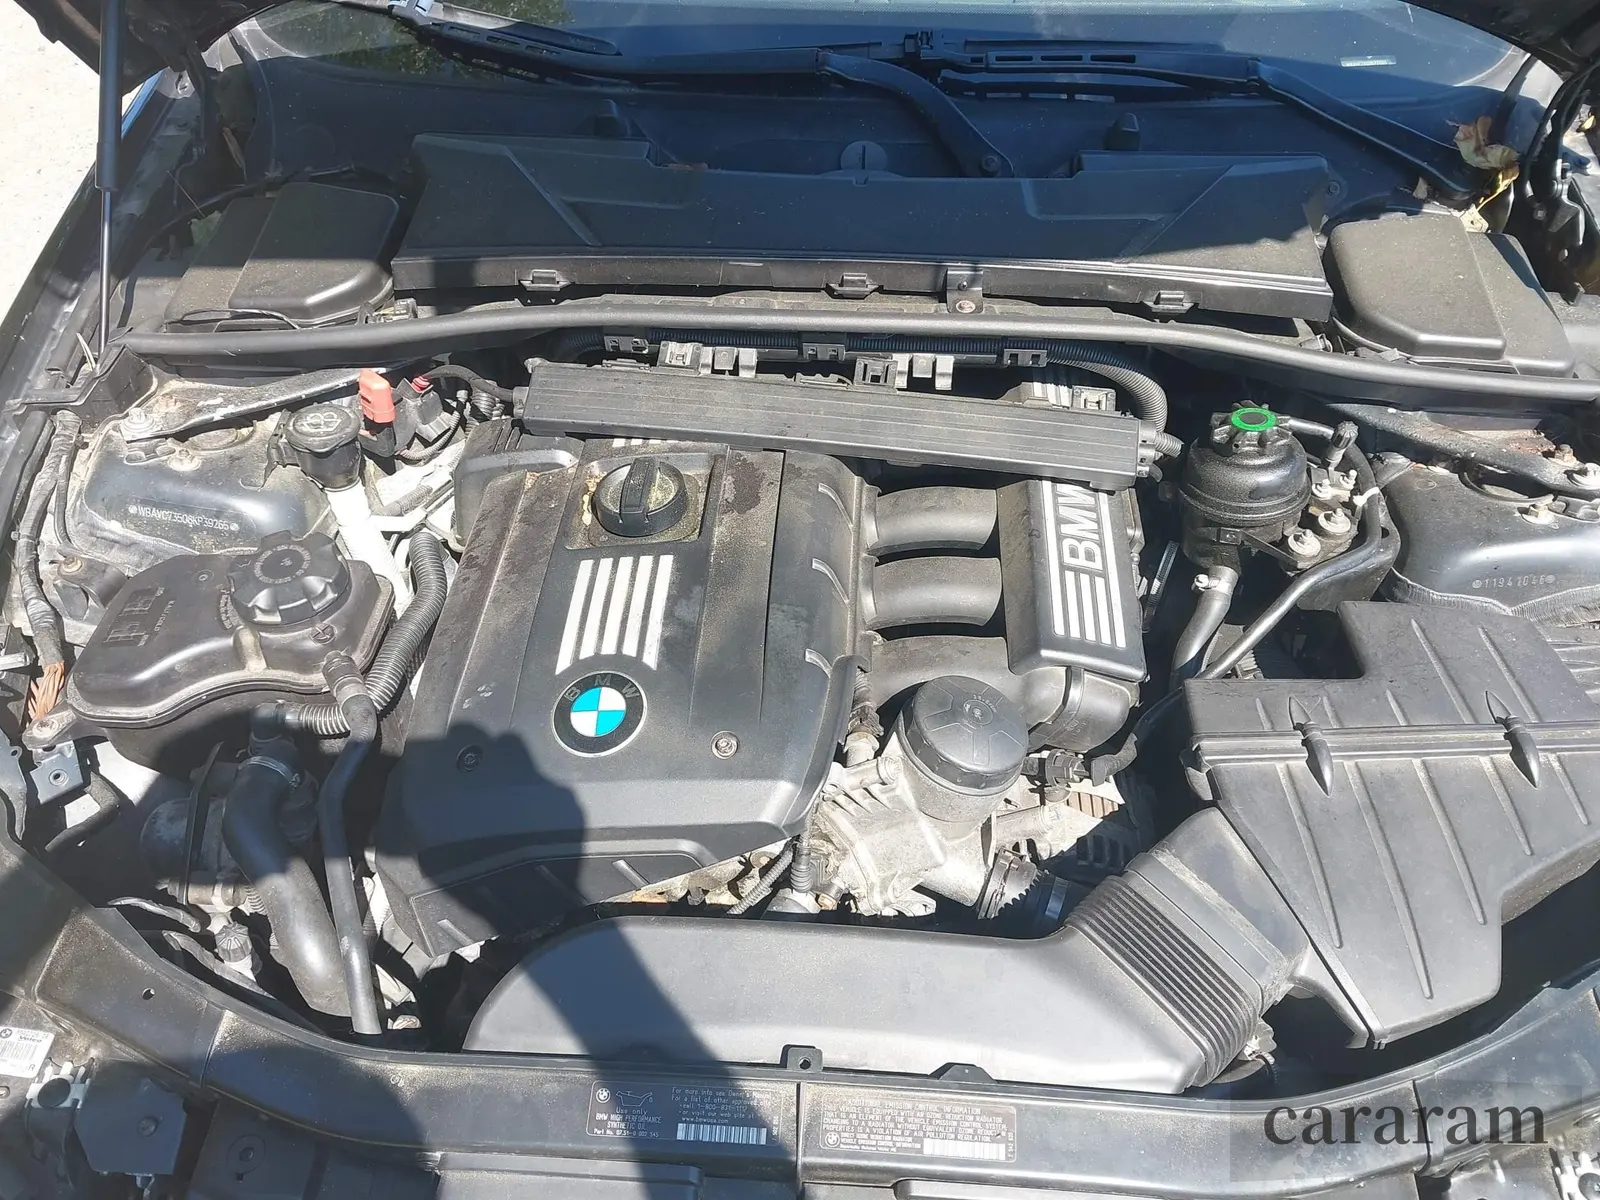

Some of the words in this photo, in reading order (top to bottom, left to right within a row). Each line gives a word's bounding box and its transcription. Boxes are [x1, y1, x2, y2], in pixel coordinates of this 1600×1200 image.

[1056, 483, 1104, 571] BMW
[564, 674, 640, 702] BMW
[885, 1101, 912, 1109] EMISSION
[914, 1103, 940, 1112] CONTROL
[943, 1105, 981, 1114] INFORMATION
[607, 1121, 636, 1129] SYNTHETIC
[610, 1113, 623, 1121] HIGH
[625, 1114, 662, 1123] PERFORMANCE
[823, 1117, 850, 1125] CHANGING
[922, 1125, 956, 1133] EQUIVALENT
[858, 1113, 882, 1121] ELEMENT
[908, 1117, 930, 1125] VEHICLE
[932, 1119, 958, 1127] EMISSION
[945, 1113, 974, 1121] REDUCTION
[976, 1116, 1003, 1124] RADIATOR
[822, 1124, 855, 1132] PROPERTIES
[872, 1127, 902, 1135] VIOLATION
[926, 1131, 956, 1139] POLLUTION
